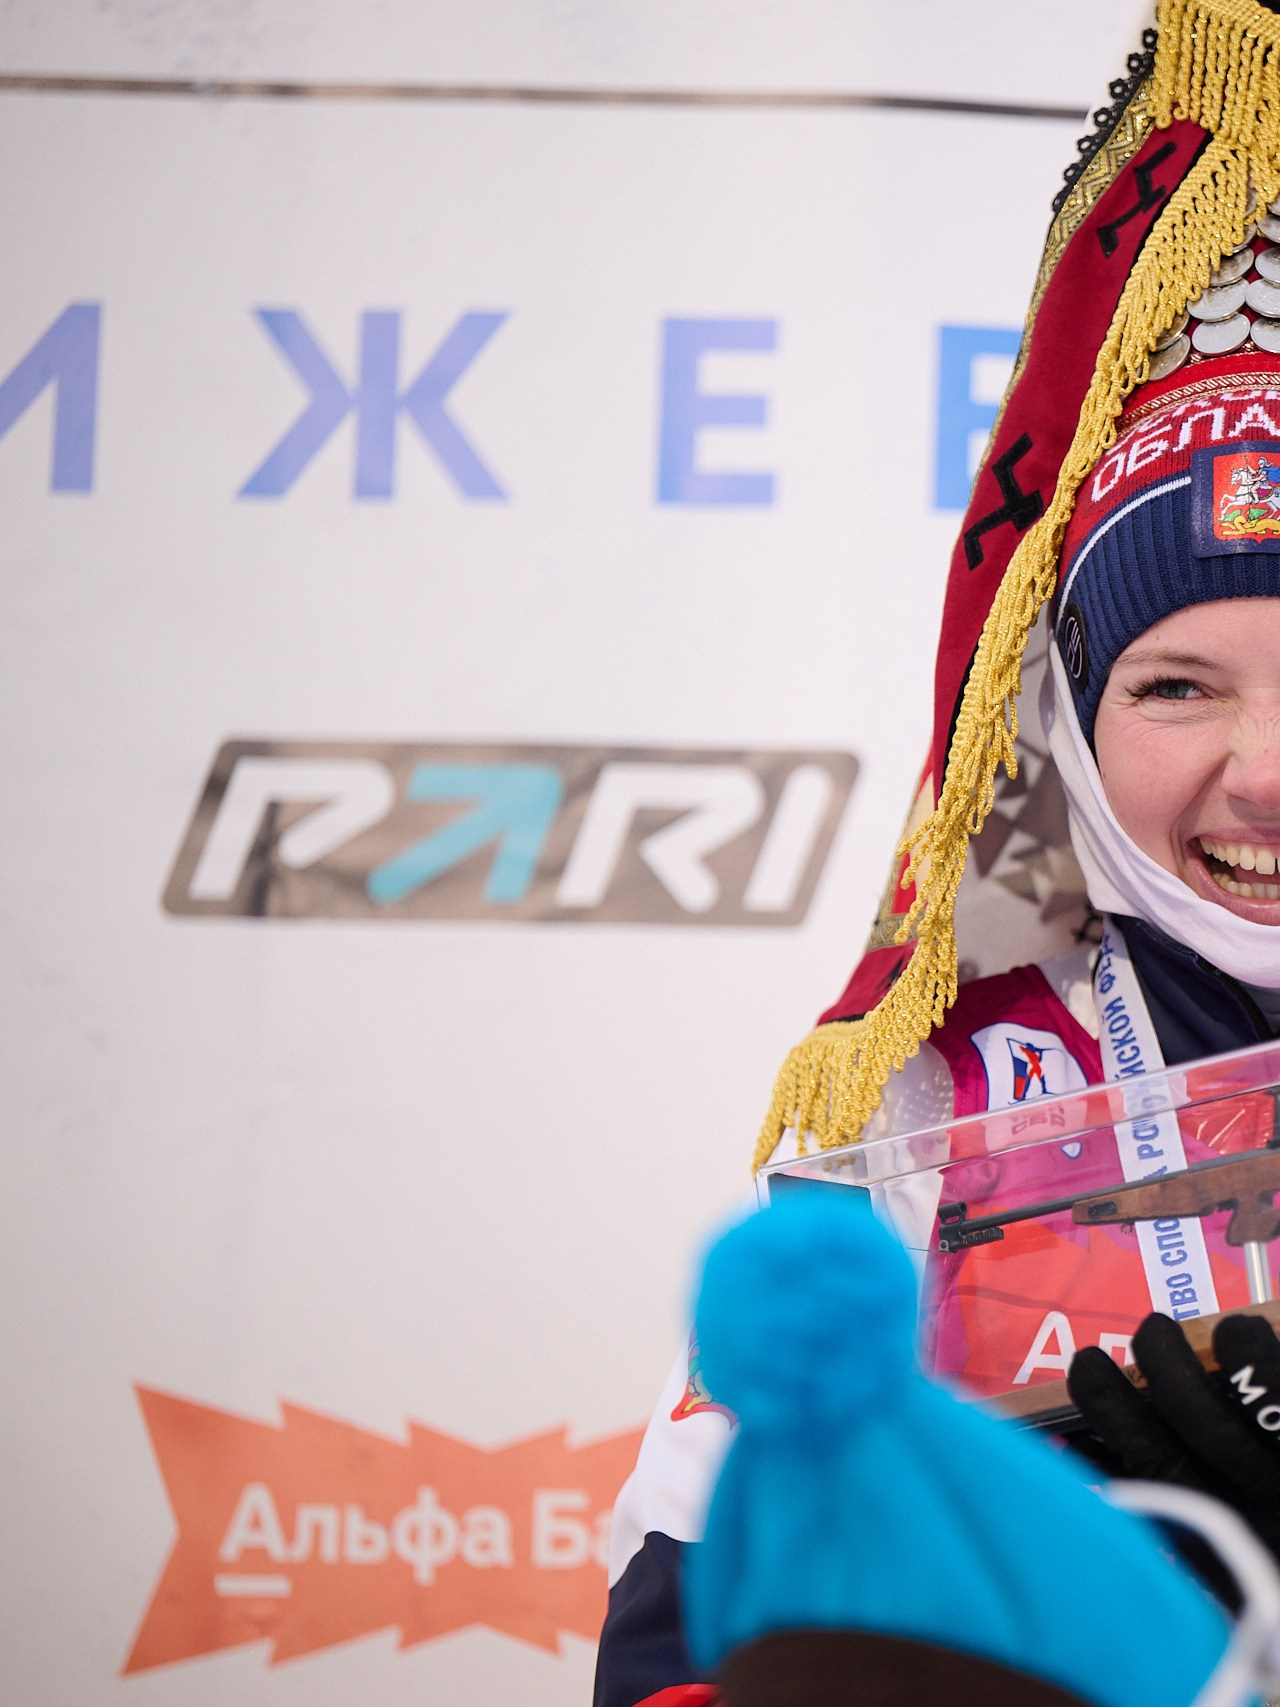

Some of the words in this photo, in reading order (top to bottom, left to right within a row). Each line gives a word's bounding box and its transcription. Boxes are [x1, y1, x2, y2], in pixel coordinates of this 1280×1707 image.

[188, 756, 836, 915] PARI
[1143, 1165, 1190, 1267] СПОА
[214, 1481, 517, 1592] Альфа
